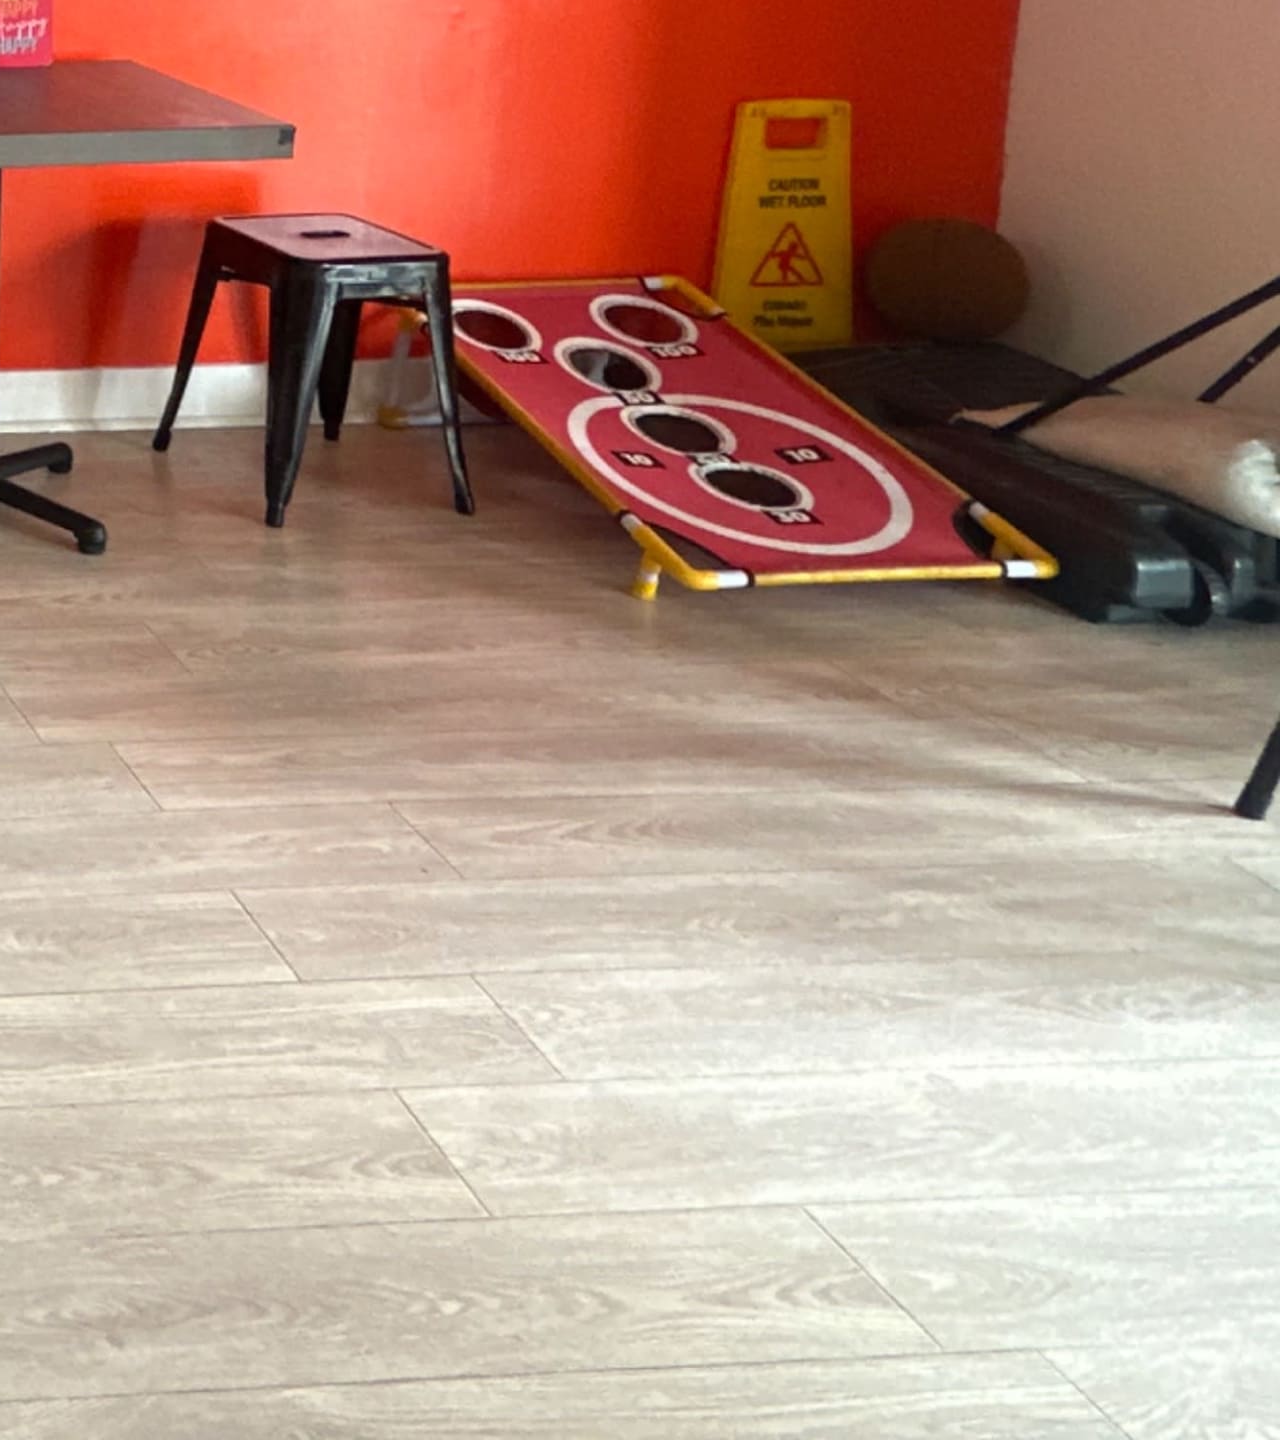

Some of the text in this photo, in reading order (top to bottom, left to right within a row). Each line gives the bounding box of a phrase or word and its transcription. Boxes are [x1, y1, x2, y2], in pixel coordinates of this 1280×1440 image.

[768, 178, 820, 191] CAUTION
[759, 195, 827, 208] WET FLOOR
[652, 346, 698, 358] 100
[620, 452, 655, 467] 10
[785, 448, 820, 462] 10
